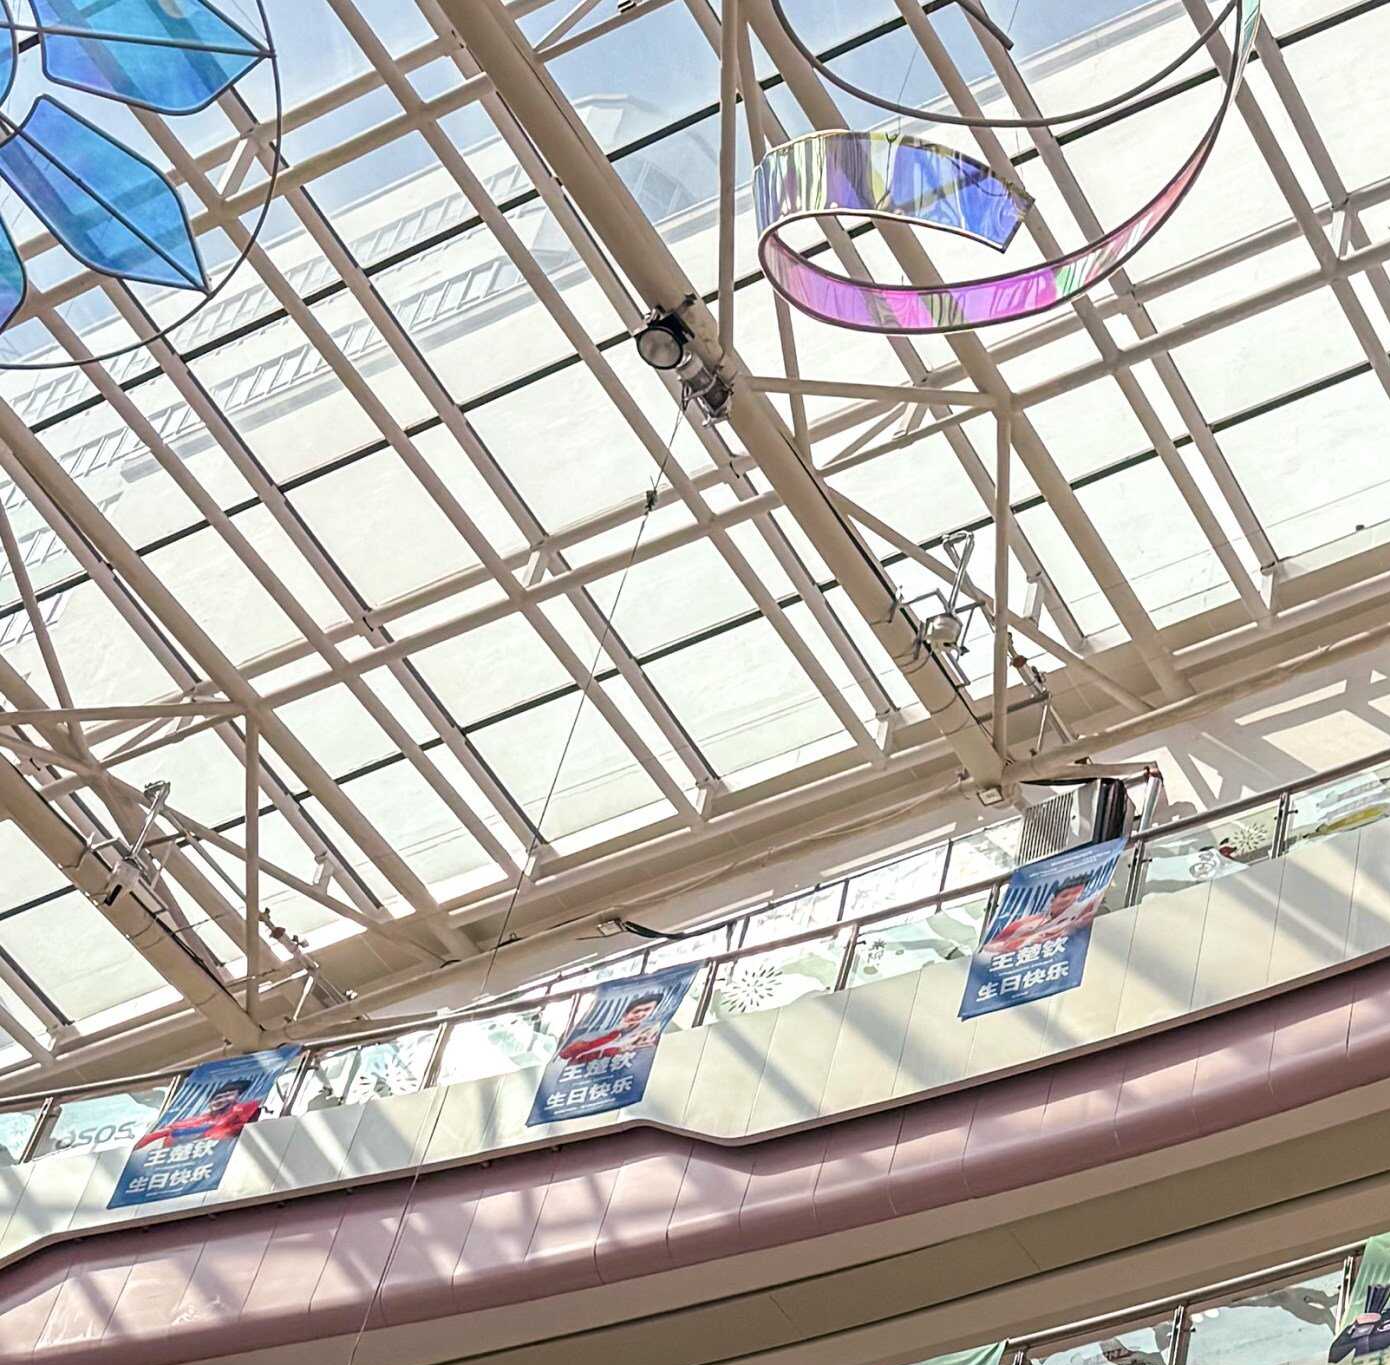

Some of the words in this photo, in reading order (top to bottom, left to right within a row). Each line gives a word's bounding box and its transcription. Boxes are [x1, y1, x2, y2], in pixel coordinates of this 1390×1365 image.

[989, 937, 1070, 972] 王楚钦
[975, 961, 1069, 1002] 生日快乐
[558, 1052, 636, 1083] 王楚钦
[543, 1075, 633, 1110] 生日快乐
[143, 1140, 219, 1168] 王楚钦
[125, 1163, 213, 1194] 生日快乐
